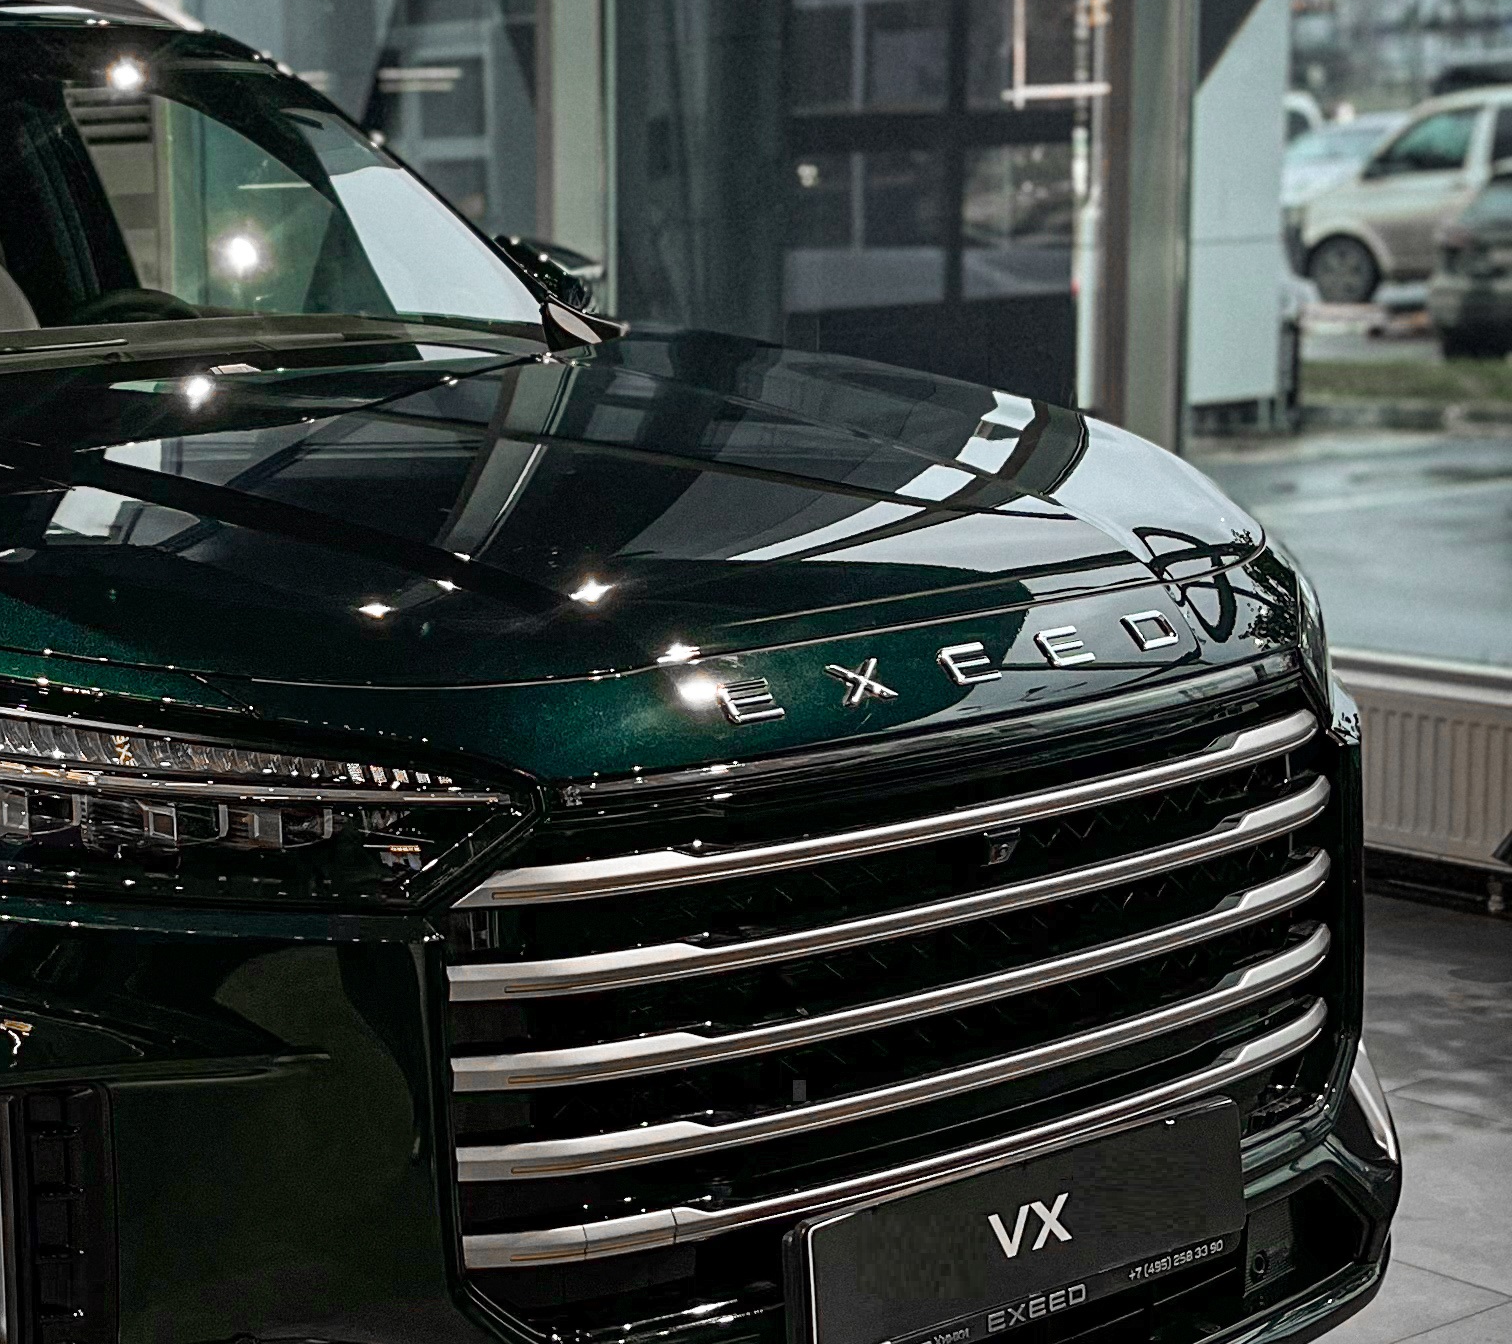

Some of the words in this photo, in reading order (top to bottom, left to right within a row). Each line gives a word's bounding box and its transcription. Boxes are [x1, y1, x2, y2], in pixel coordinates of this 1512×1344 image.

[715, 609, 1180, 724] EXEED
[988, 1192, 1074, 1259] VX
[1128, 1266, 1142, 1281] +7
[1143, 1255, 1172, 1278] (495)
[1173, 1250, 1194, 1267] 258
[1194, 1244, 1209, 1260] 33
[987, 1283, 1087, 1333] EXEED
